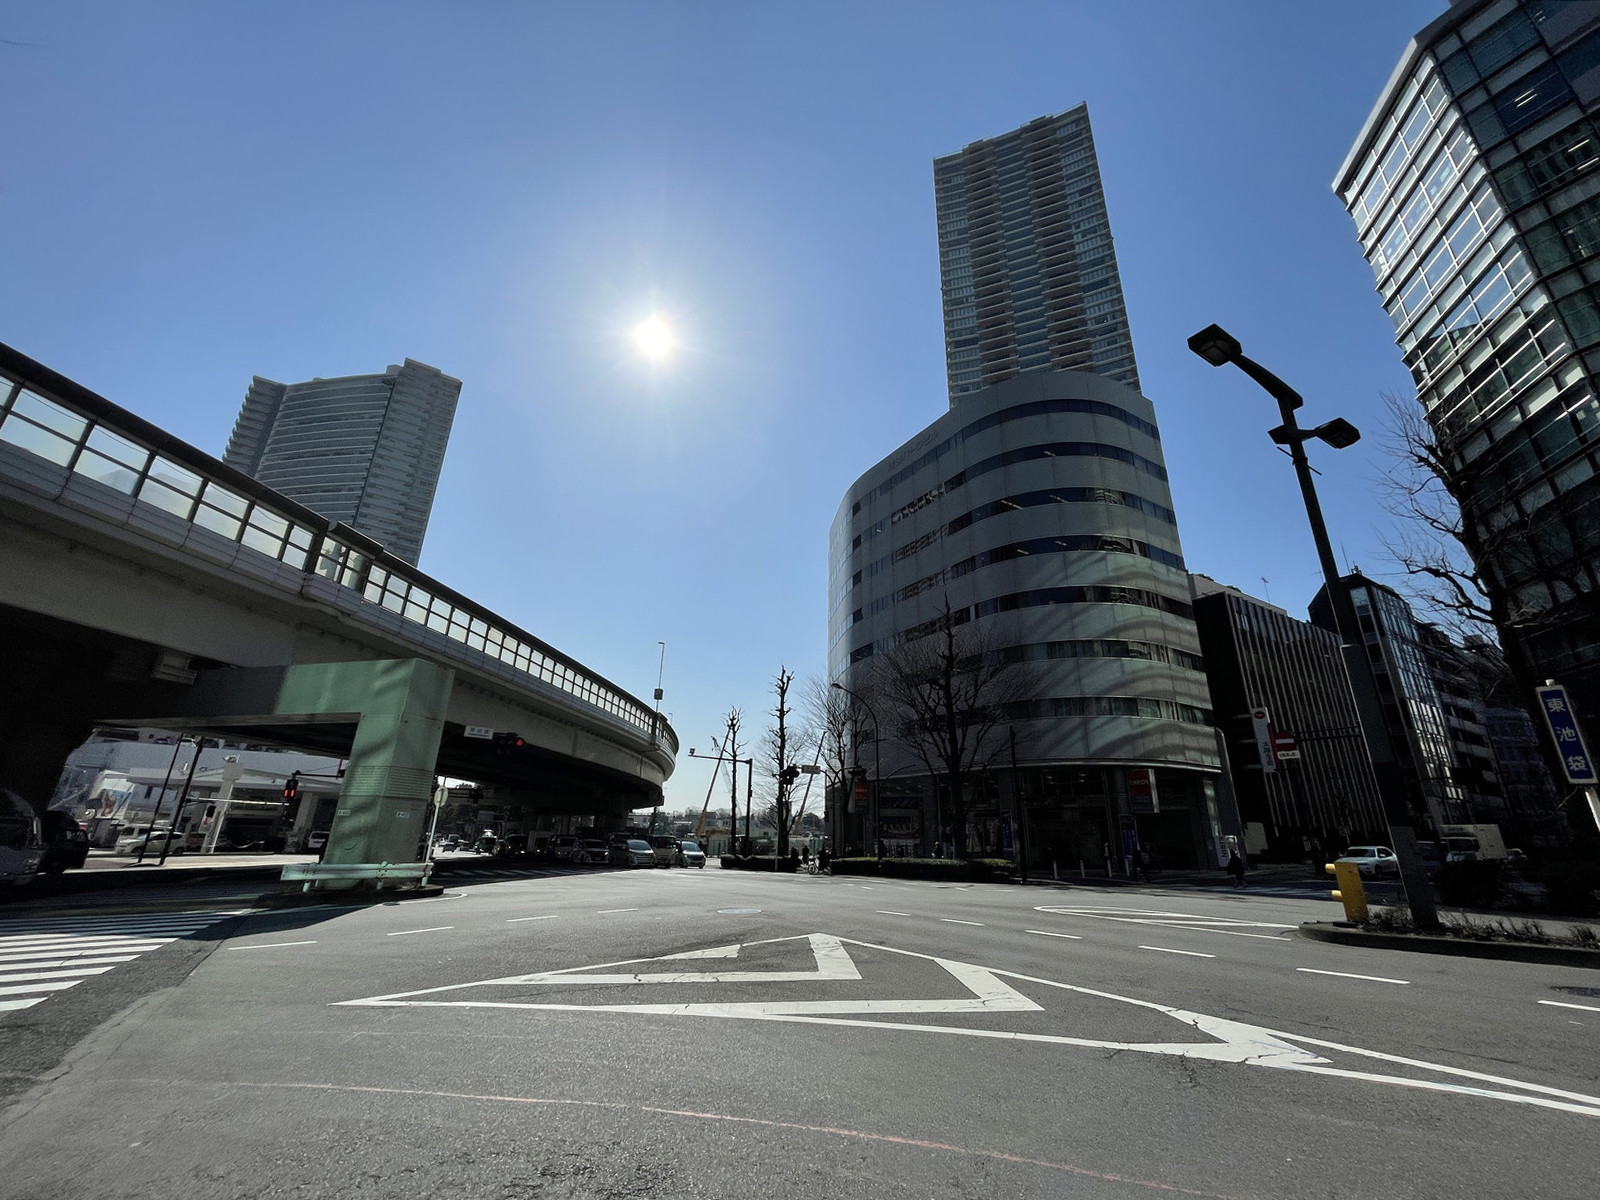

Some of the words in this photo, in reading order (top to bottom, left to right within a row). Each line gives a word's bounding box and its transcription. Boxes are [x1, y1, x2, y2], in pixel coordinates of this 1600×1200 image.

[1546, 698, 1588, 771] 東池袋
[1218, 836, 1228, 857] KIRIN
